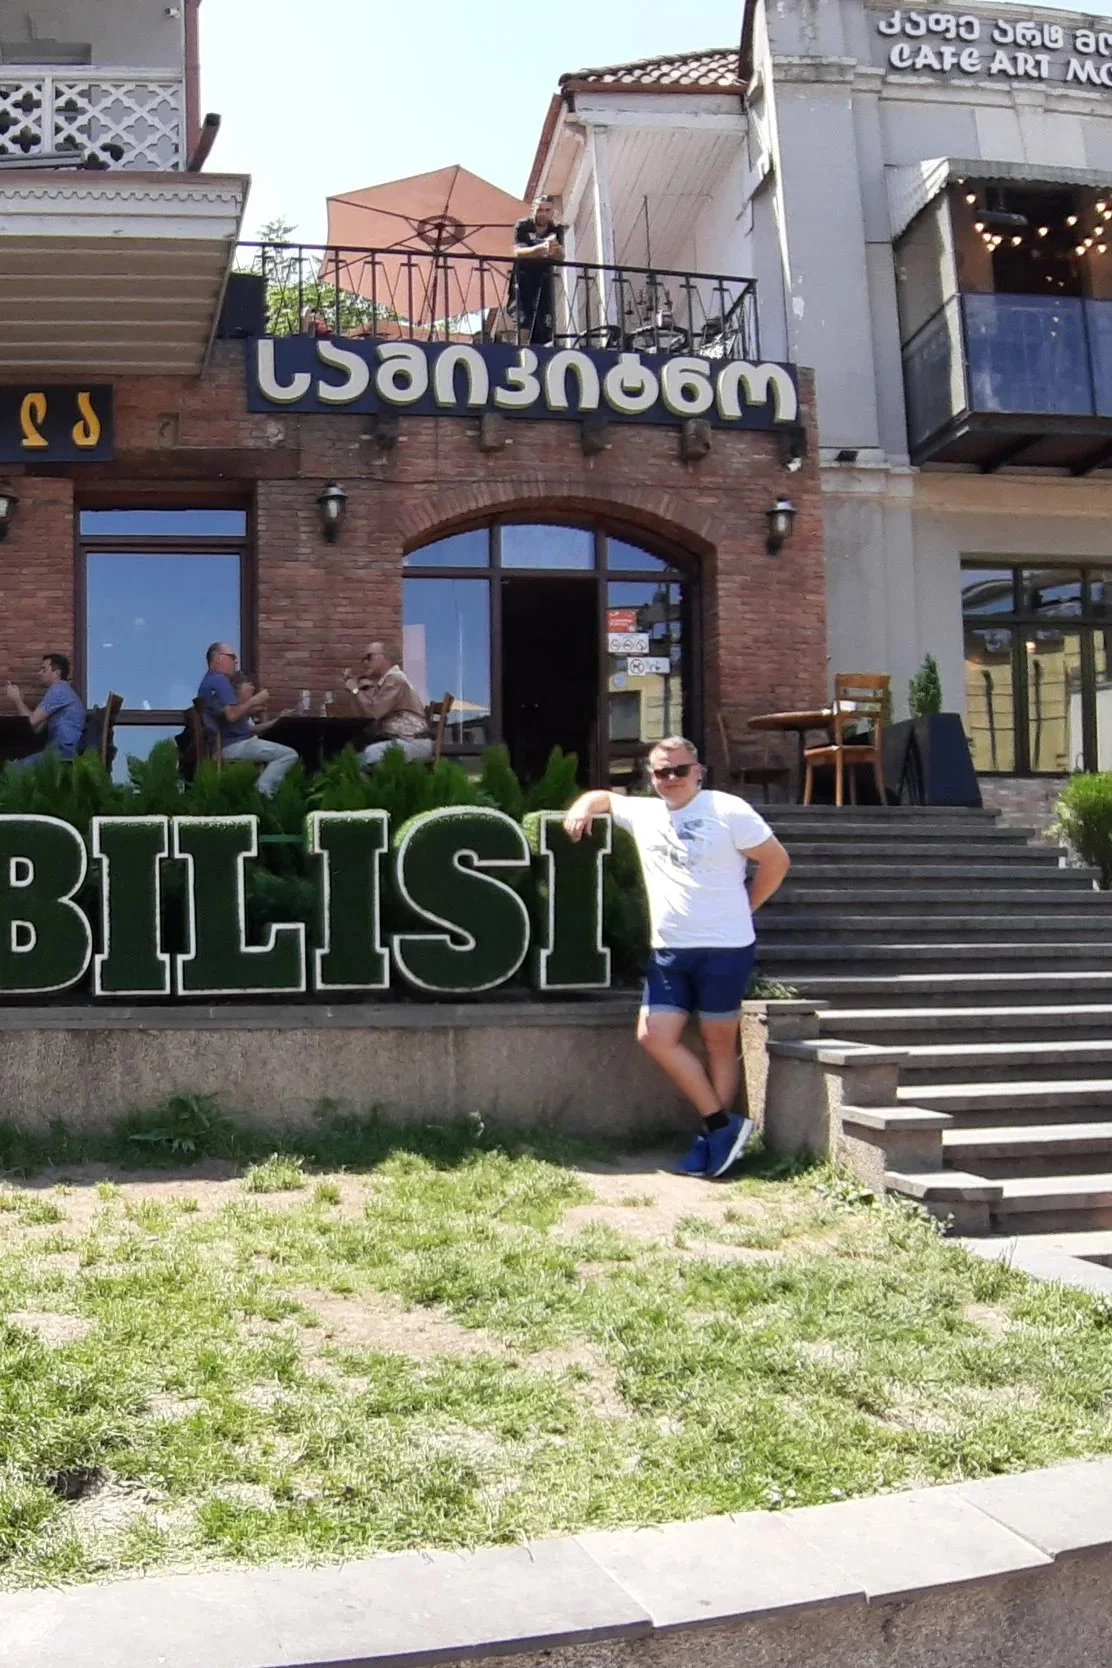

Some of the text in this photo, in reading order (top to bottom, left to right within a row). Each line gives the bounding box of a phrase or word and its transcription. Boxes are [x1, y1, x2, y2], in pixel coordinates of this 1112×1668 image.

[878, 10, 980, 41] კაფე
[992, 19, 1064, 49] არტ
[990, 50, 1050, 79] ART
[256, 339, 799, 424] სამიკიტნო
